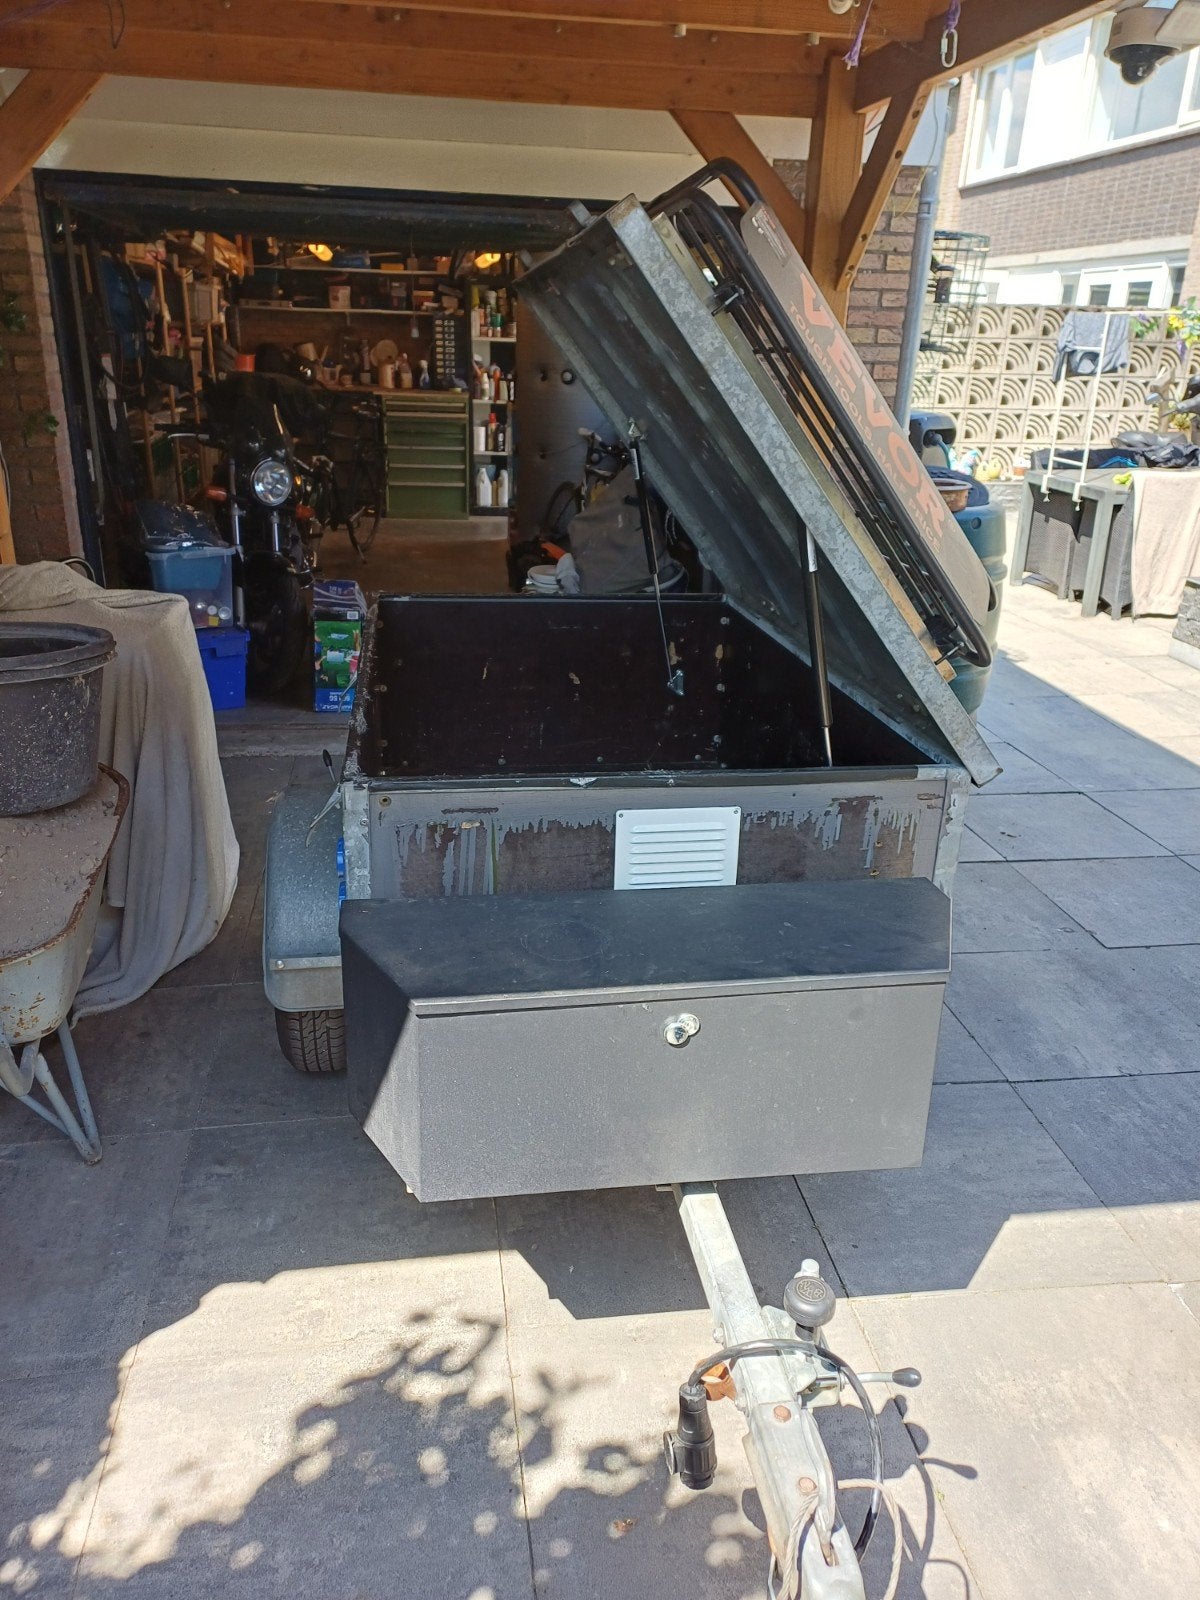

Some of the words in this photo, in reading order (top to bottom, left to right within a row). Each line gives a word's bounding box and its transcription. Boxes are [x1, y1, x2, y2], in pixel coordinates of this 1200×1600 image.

[789, 301, 832, 374] TOUGH
[908, 498, 941, 553] PRICE
[800, 272, 945, 538] VEVOR
